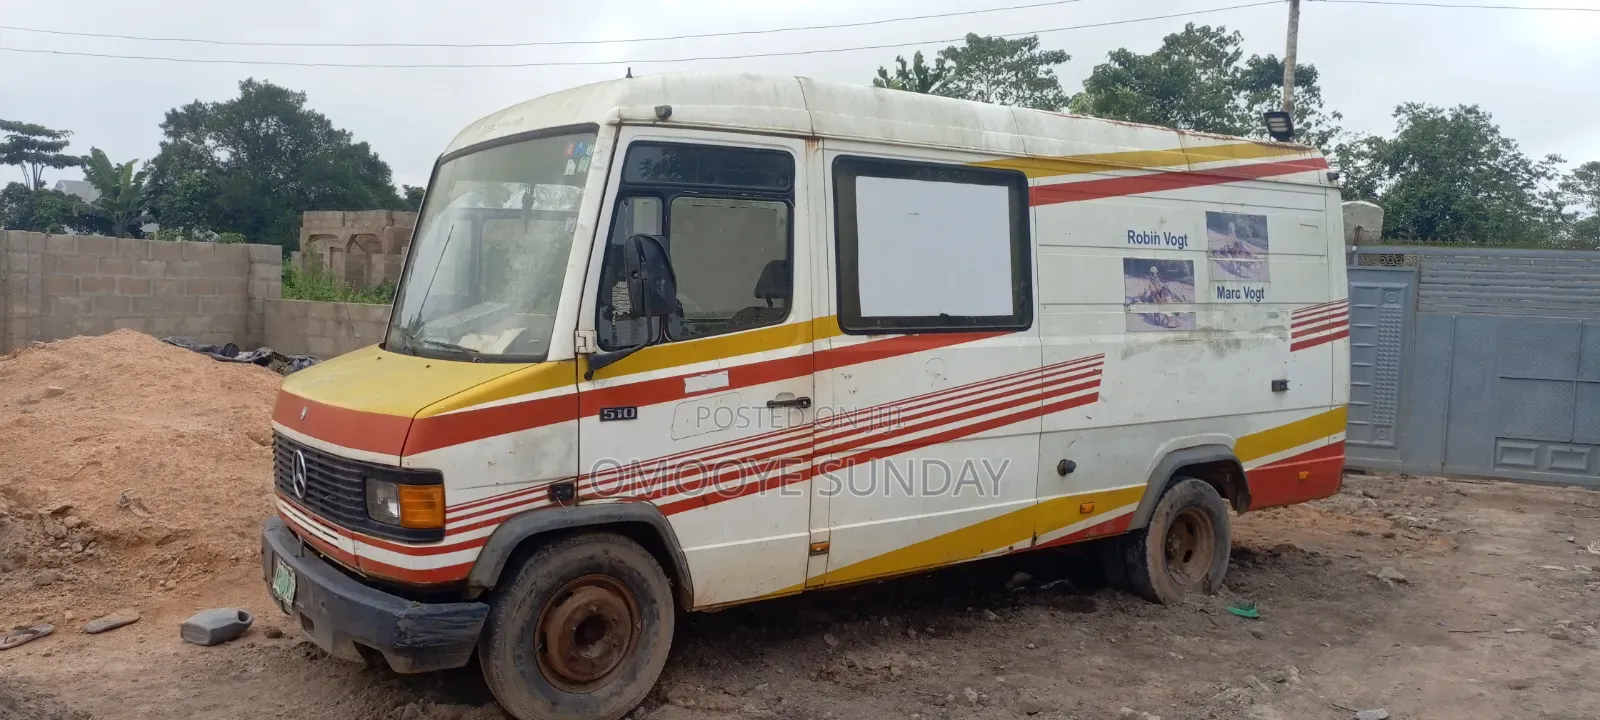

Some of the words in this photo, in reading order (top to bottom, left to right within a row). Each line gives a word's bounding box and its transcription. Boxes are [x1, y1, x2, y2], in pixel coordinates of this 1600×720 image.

[1127, 229, 1161, 245] Robin
[1163, 231, 1189, 249] Vogt
[1216, 285, 1241, 299] Marc
[1242, 286, 1265, 302] Vogt
[603, 408, 635, 419] 510
